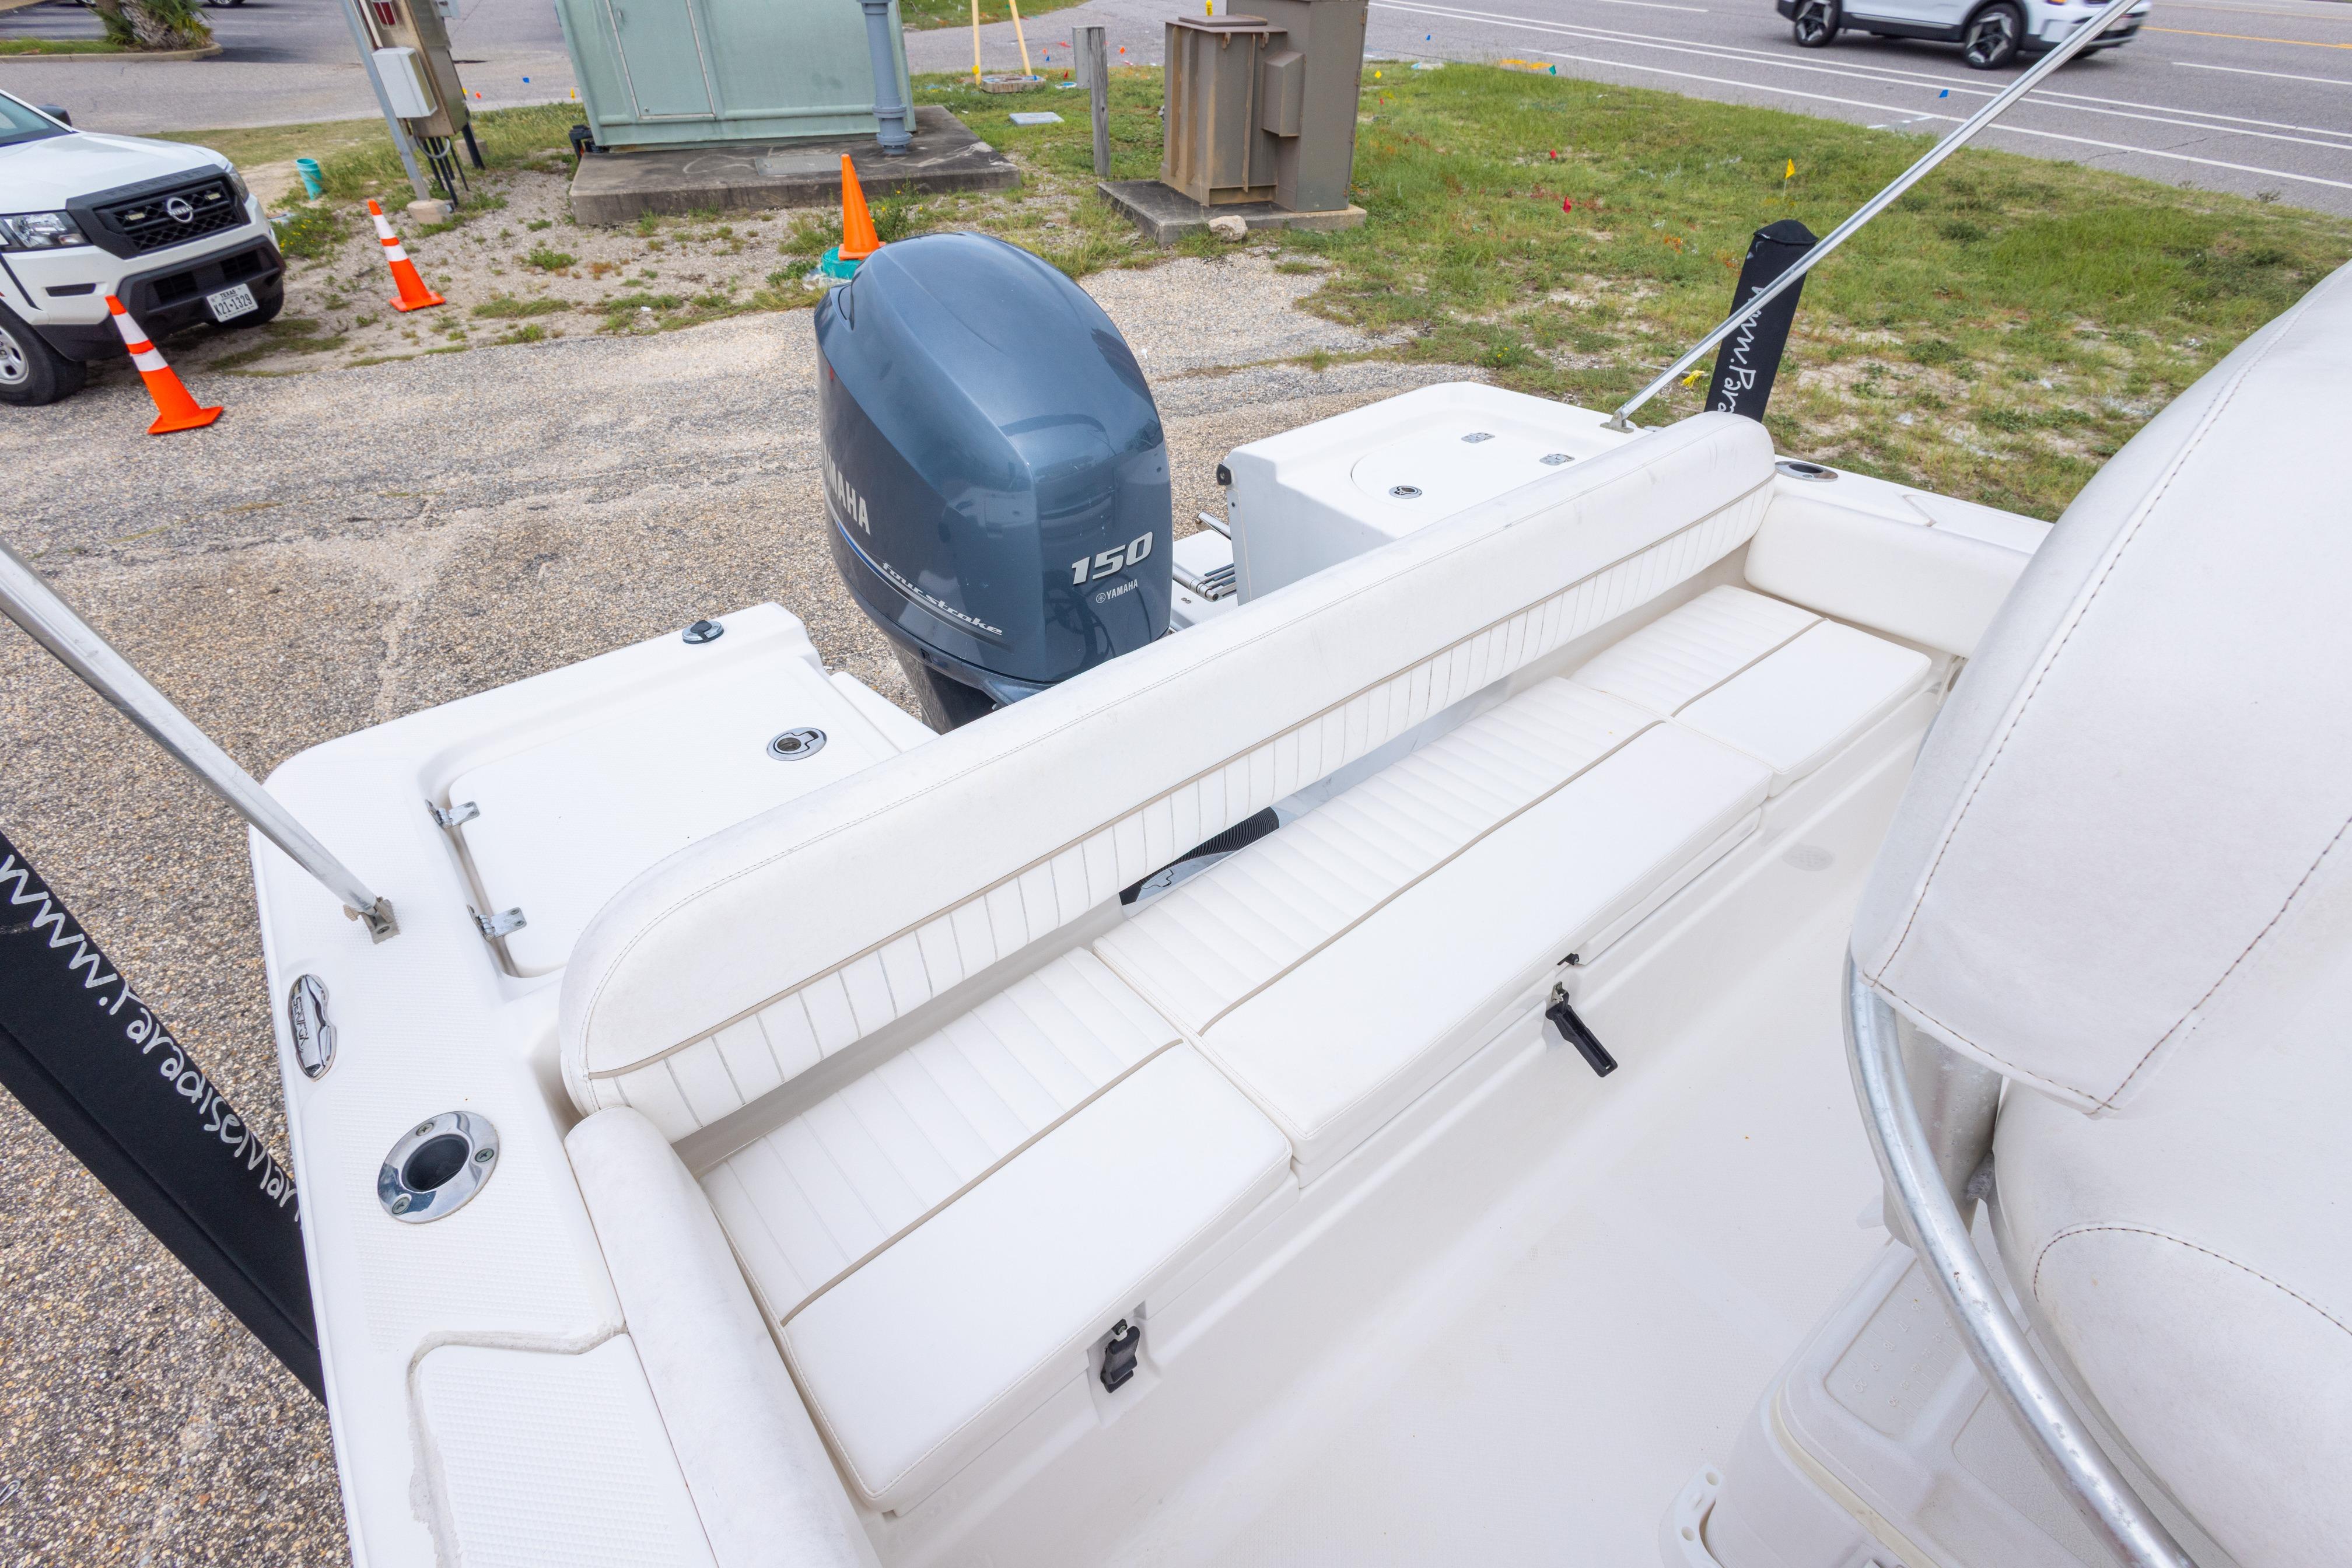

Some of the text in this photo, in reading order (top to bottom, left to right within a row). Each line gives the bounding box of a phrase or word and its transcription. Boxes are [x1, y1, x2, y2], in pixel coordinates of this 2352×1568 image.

[168, 205, 193, 216] NISSAN
[219, 289, 236, 298] TEXAS
[1071, 531, 1153, 584] 150
[1106, 579, 1138, 600] YAMAHA
[1853, 1377, 1867, 1393] 20
